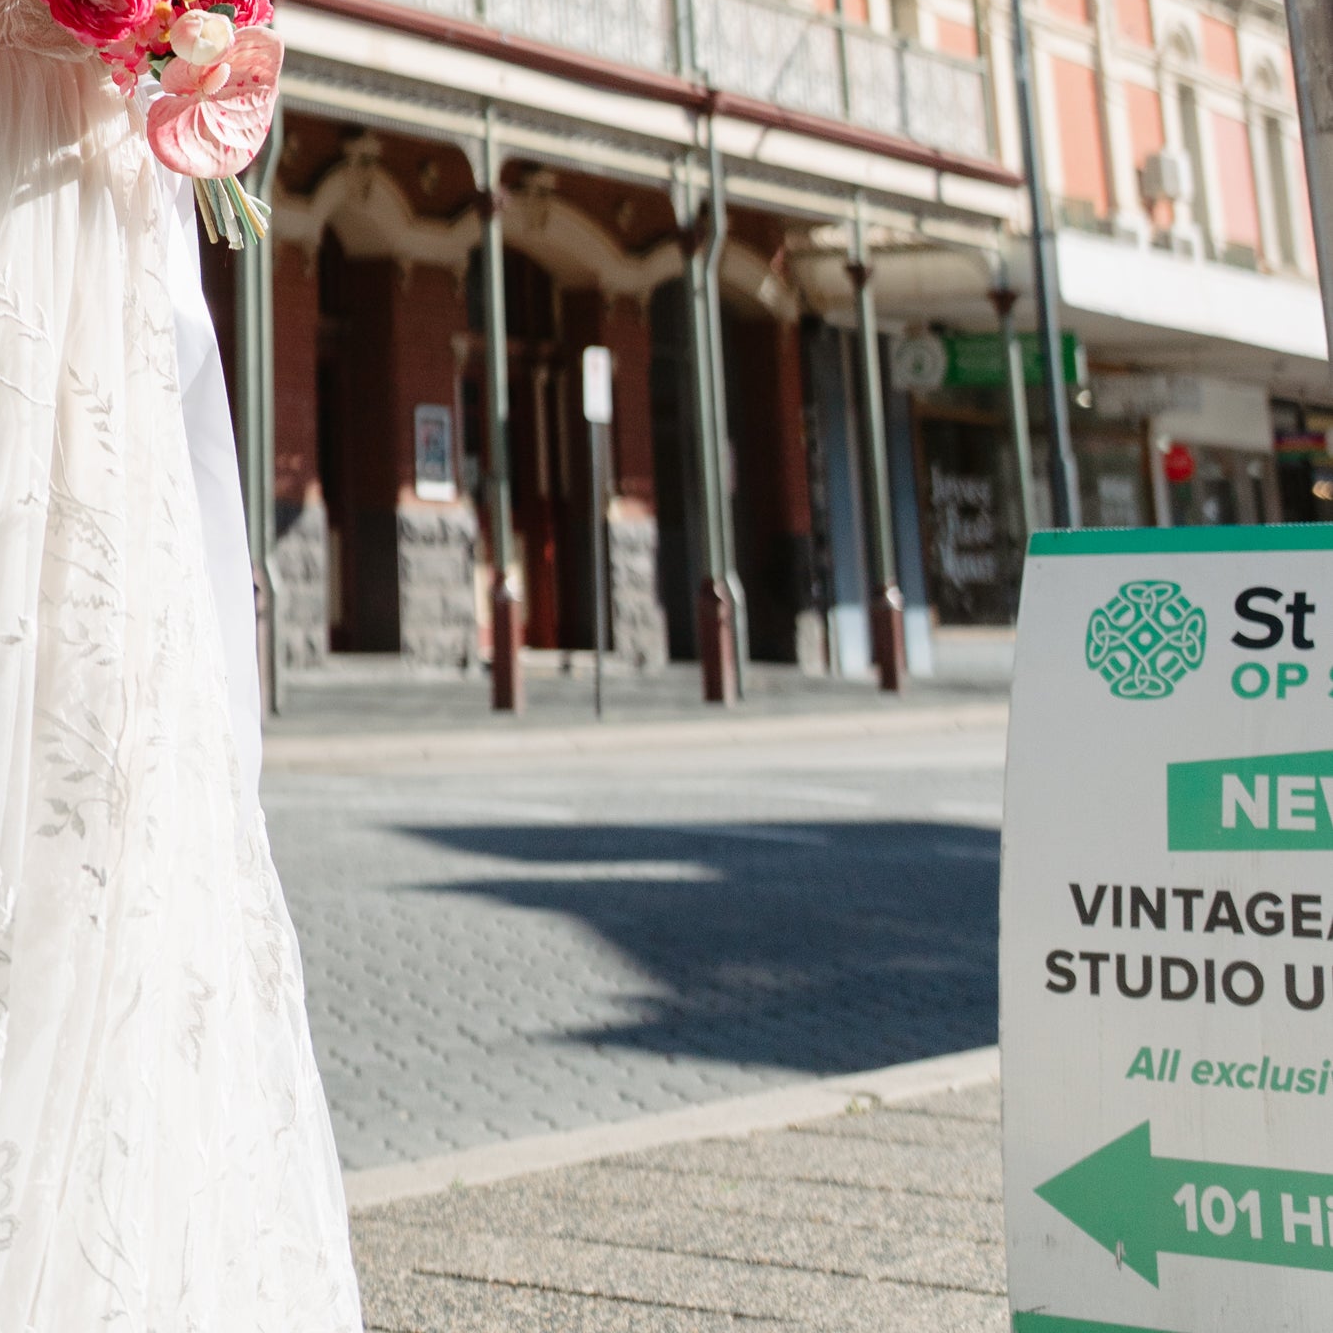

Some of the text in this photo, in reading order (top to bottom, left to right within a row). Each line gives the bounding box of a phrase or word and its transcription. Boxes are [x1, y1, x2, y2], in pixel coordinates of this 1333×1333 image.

[1231, 587, 1316, 650] St
[1231, 662, 1309, 700] OP
[1221, 773, 1333, 832] NE
[1069, 883, 1333, 941] VINTAGE
[1045, 949, 1333, 1012] STUDIO U
[1125, 1046, 1333, 1096] All exclusi
[1173, 1183, 1263, 1240] 101
